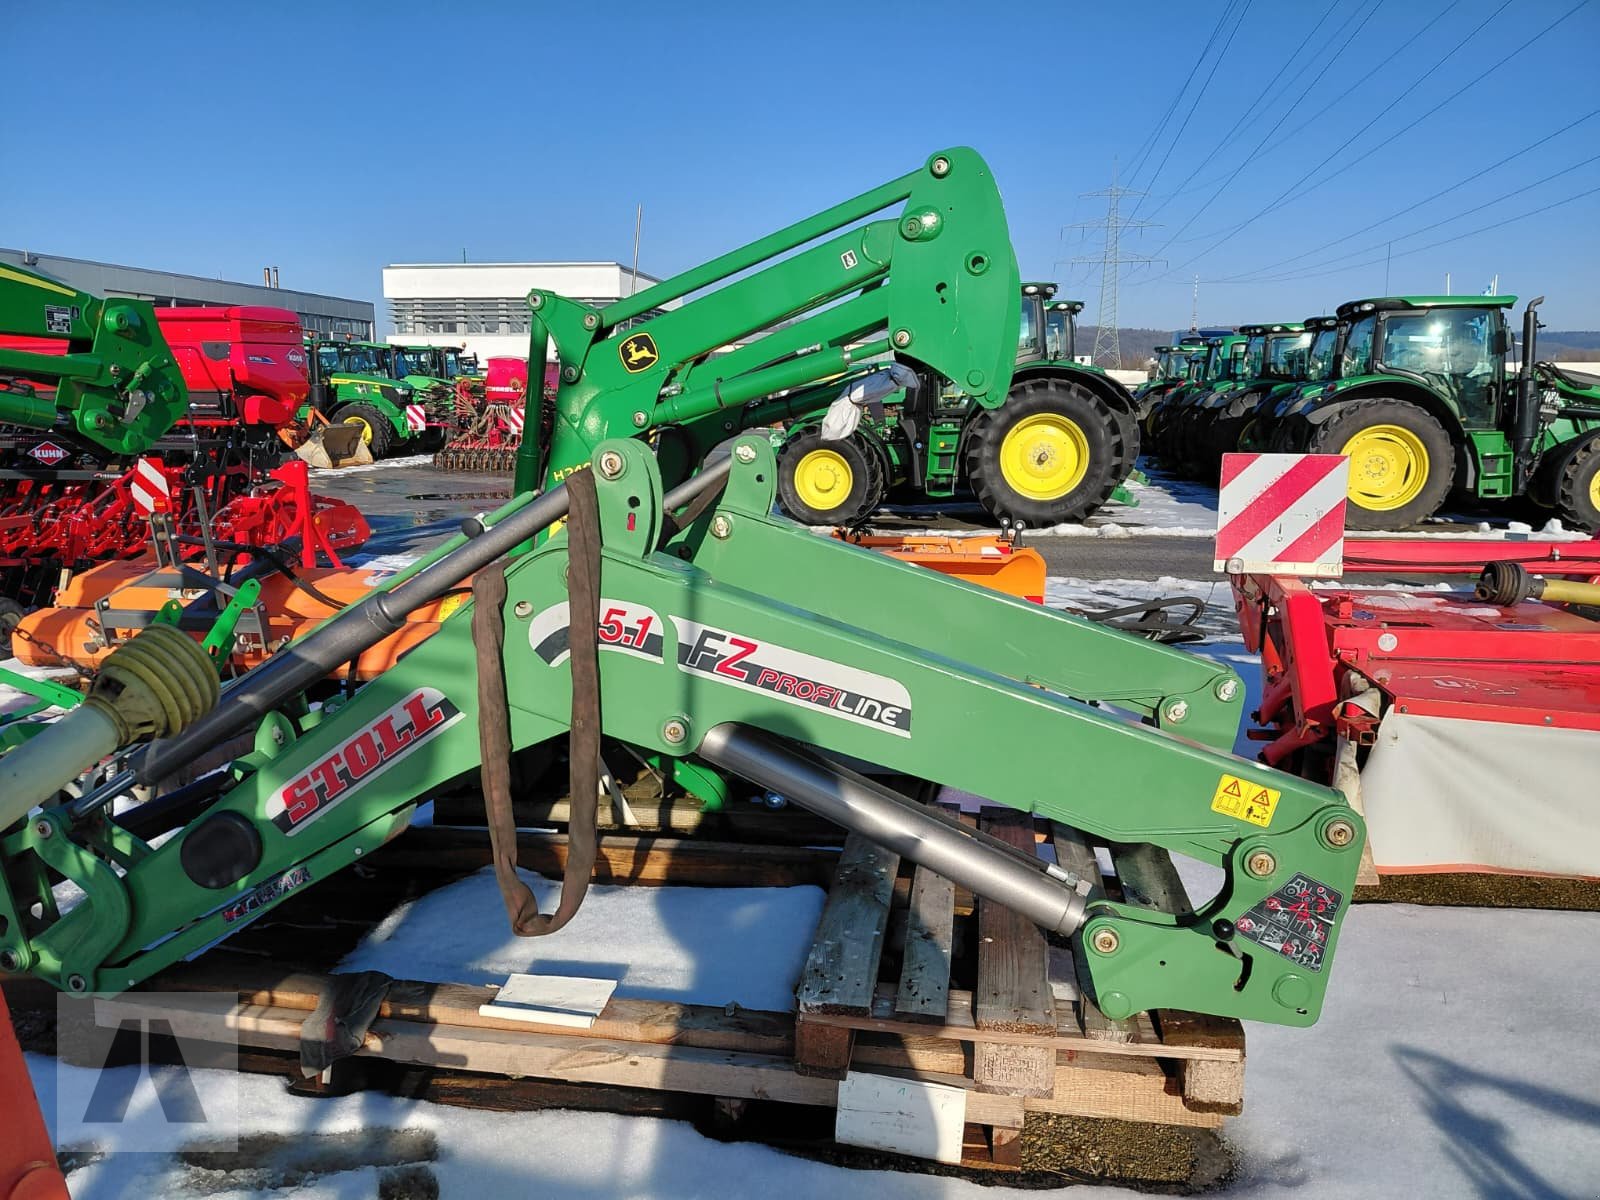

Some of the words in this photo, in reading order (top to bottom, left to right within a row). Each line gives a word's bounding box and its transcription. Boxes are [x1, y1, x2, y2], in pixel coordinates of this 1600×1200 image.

[34, 449, 64, 459] KUHN
[598, 607, 654, 649] 5.1
[685, 627, 759, 682] FZ
[756, 667, 903, 728] PROFILINE
[281, 692, 445, 825] STOLL
